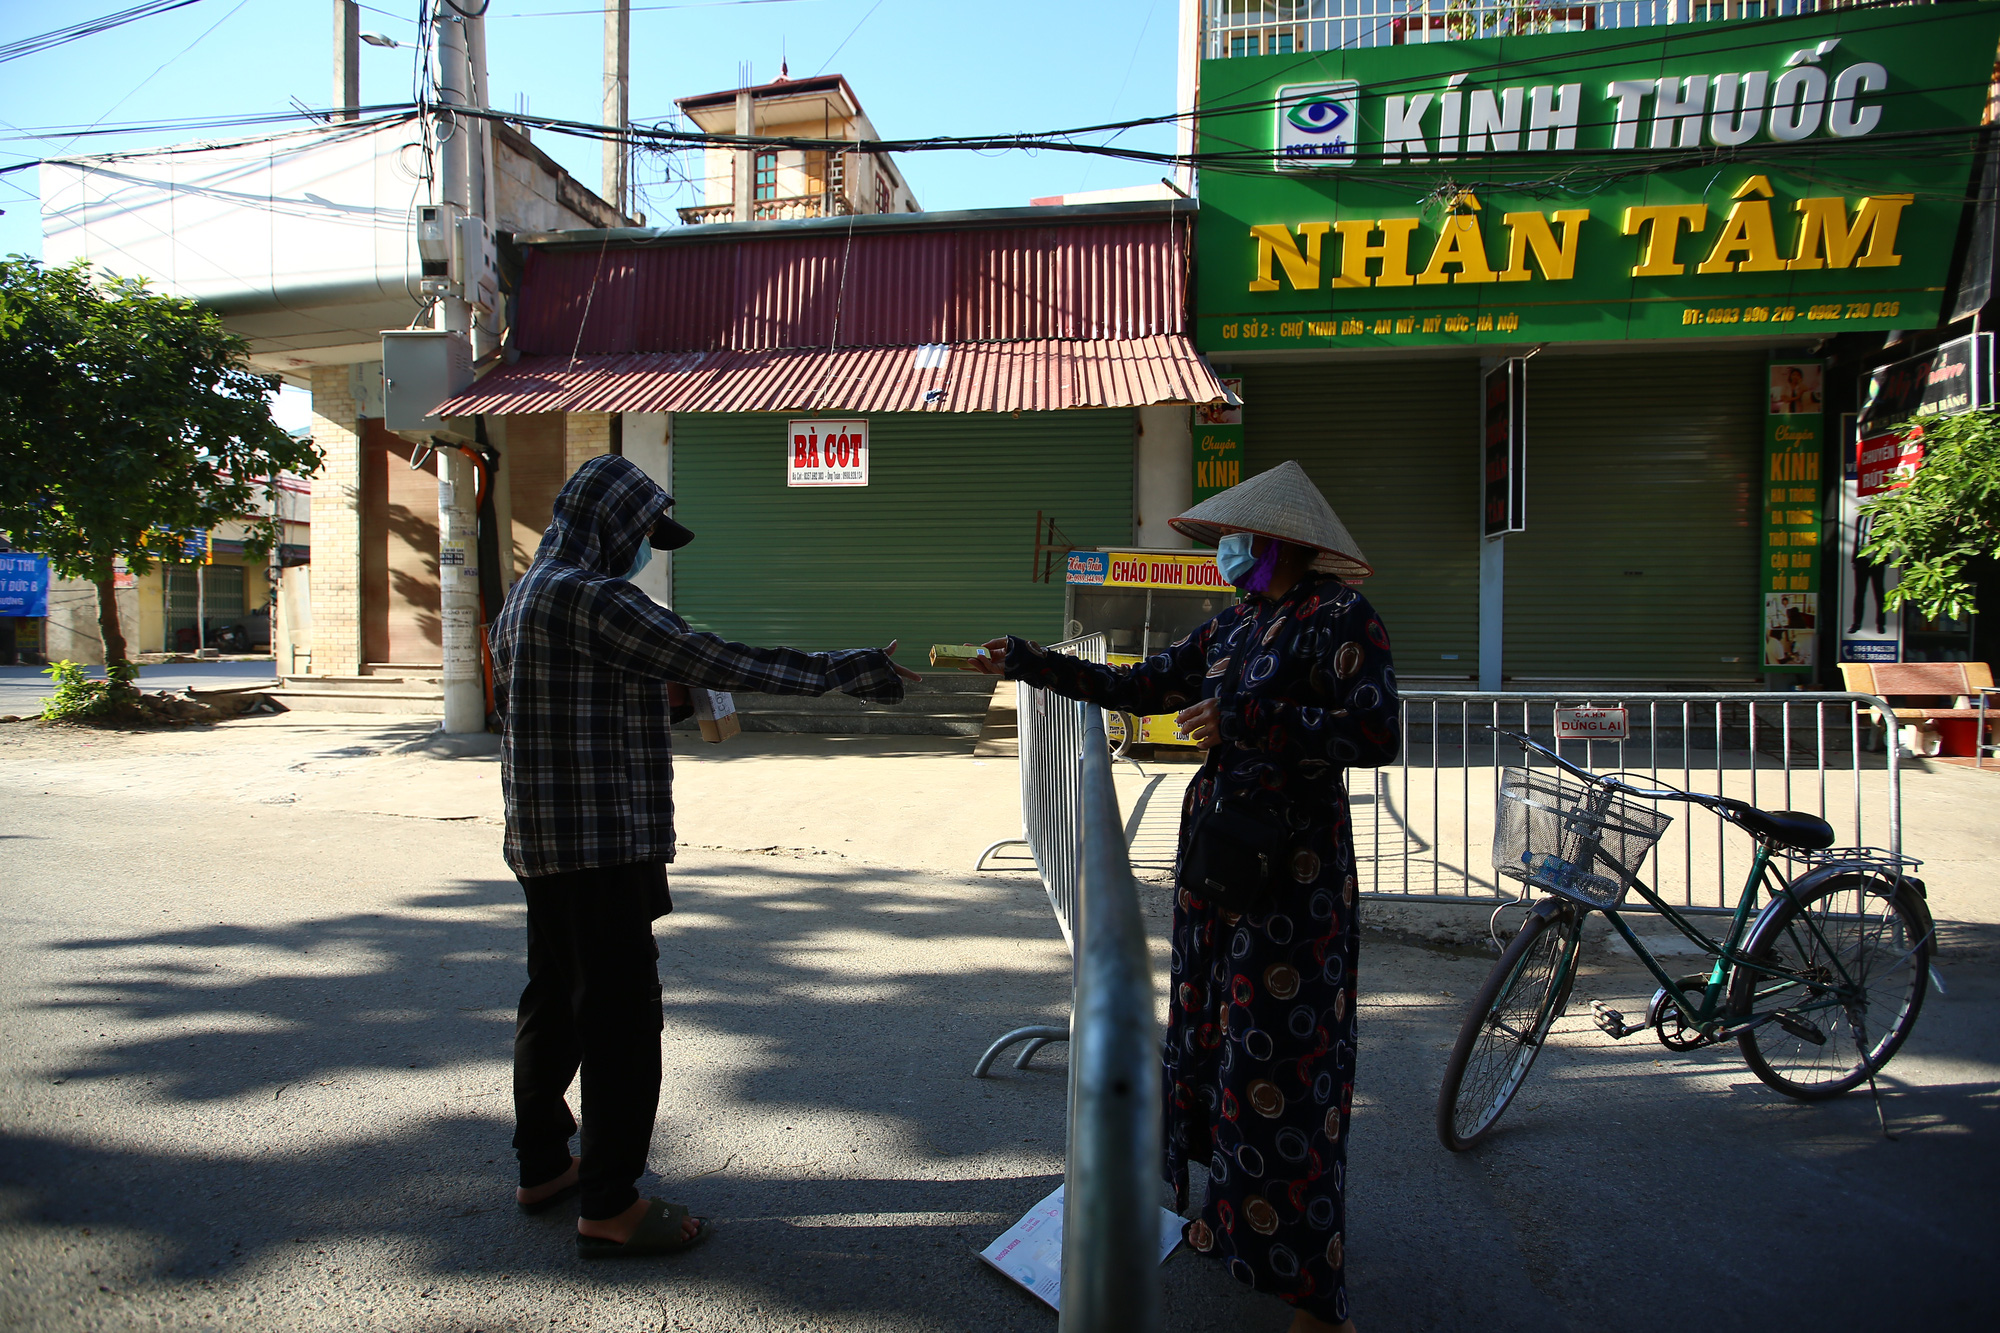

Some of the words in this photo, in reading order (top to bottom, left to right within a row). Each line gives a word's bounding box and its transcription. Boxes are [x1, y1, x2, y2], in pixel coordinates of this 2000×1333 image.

[1382, 72, 1583, 166] KÍNH
[1607, 38, 1889, 150] THUỐC
[1249, 189, 1591, 292] NHÂN
[1623, 175, 1915, 278] TÂM
[1222, 322, 1239, 339] CƠ
[1243, 318, 1259, 338] SỞ
[1280, 320, 1304, 340] CHỢ
[1497, 312, 1519, 333] NỘI
[1771, 306, 1796, 322] 216
[794, 426, 820, 468] BÀ
[824, 425, 862, 468] CÓT
[1201, 435, 1237, 457] Chuyên
[1197, 455, 1240, 488] KÍNH
[1771, 446, 1819, 481] KÍNH
[17, 559, 36, 572] THI
[1112, 558, 1147, 583] CHÁO
[1150, 562, 1183, 585] DINH
[1561, 719, 1597, 730] DỪNG
[1600, 721, 1621, 732] LẠI
